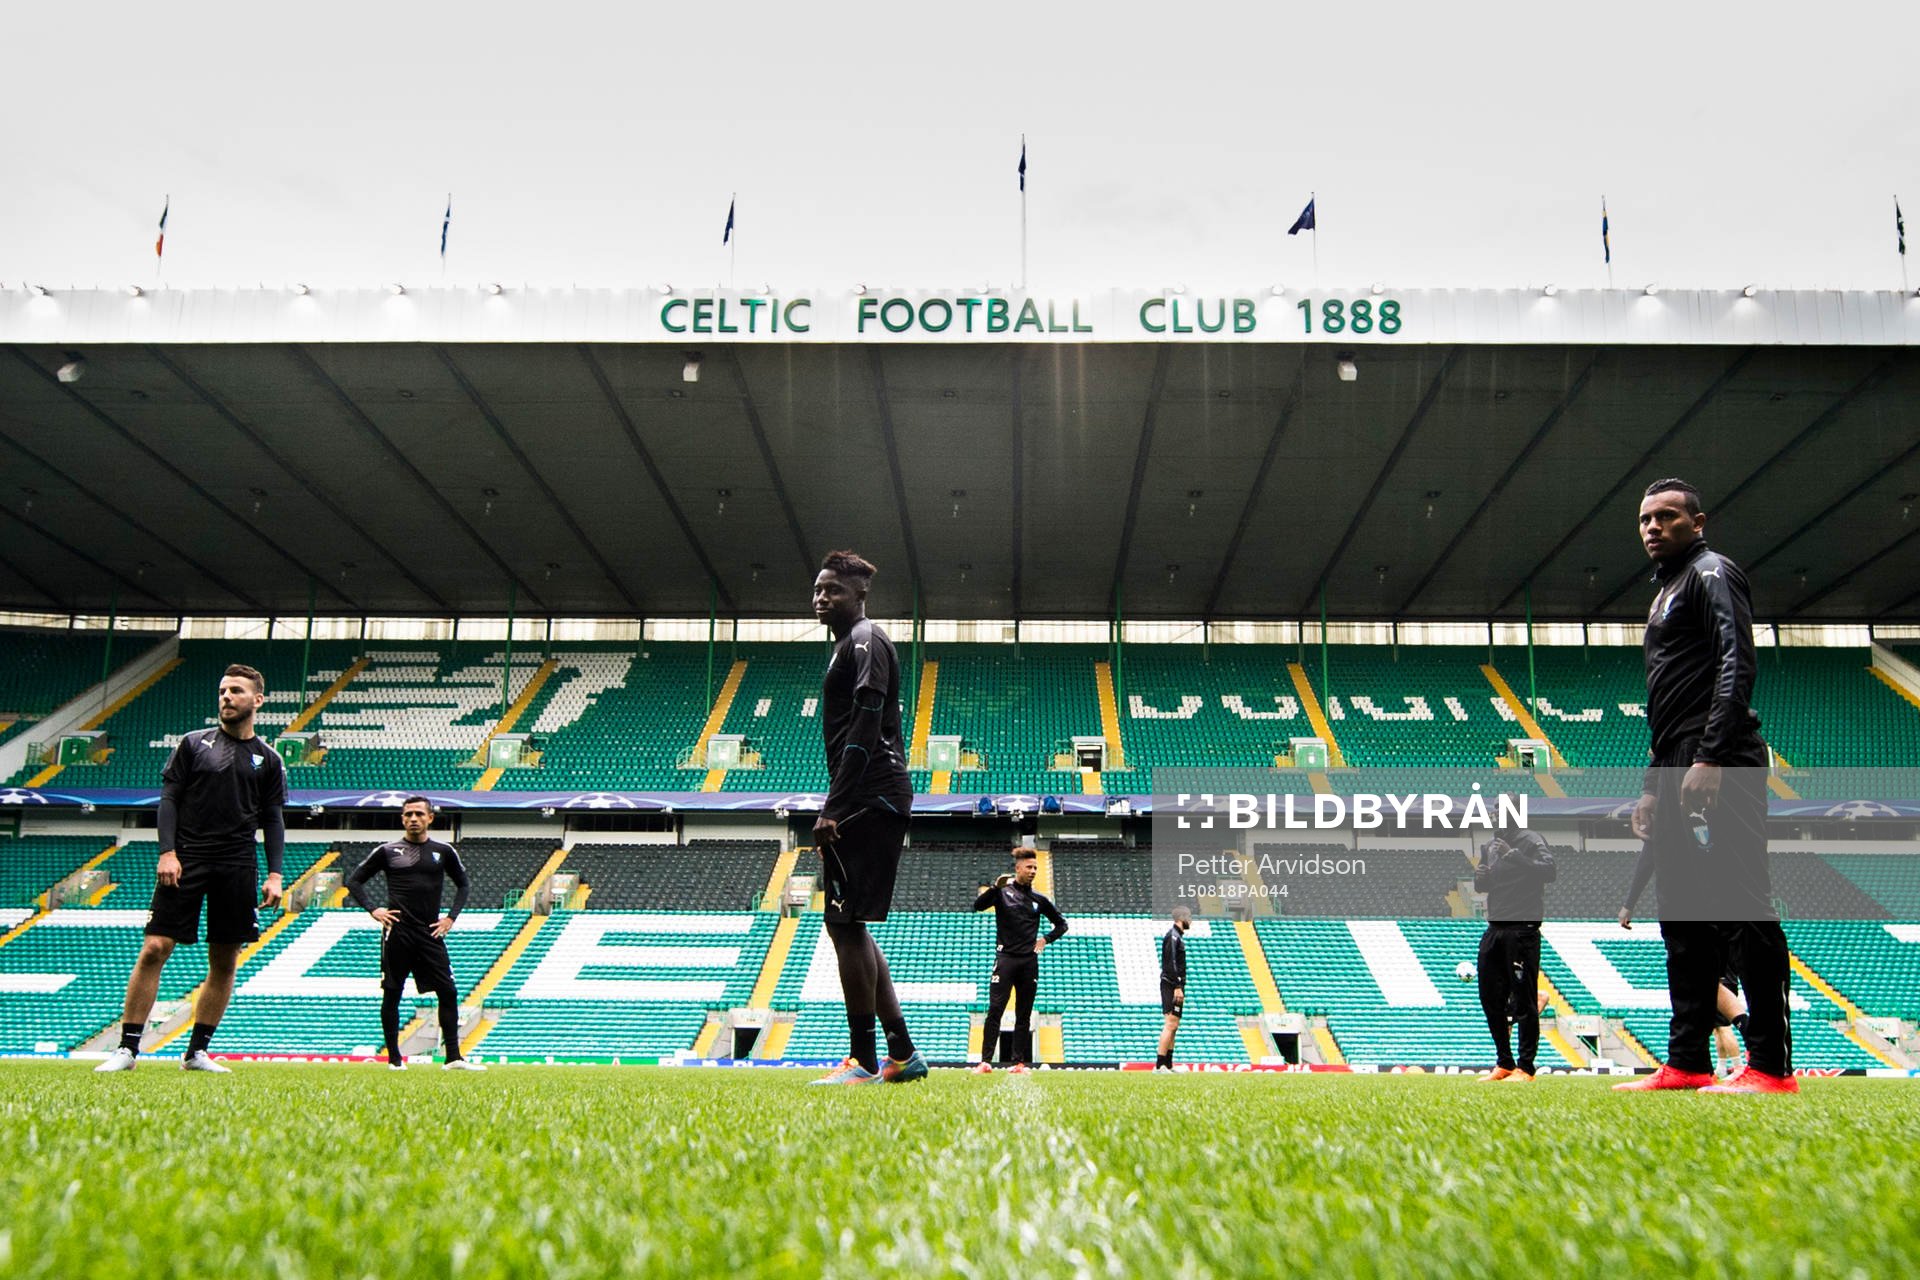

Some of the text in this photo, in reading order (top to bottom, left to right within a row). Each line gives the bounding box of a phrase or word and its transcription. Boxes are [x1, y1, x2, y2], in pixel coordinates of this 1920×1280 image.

[660, 298, 1403, 334] CELTIC FOOTBALL CLUB 1888
